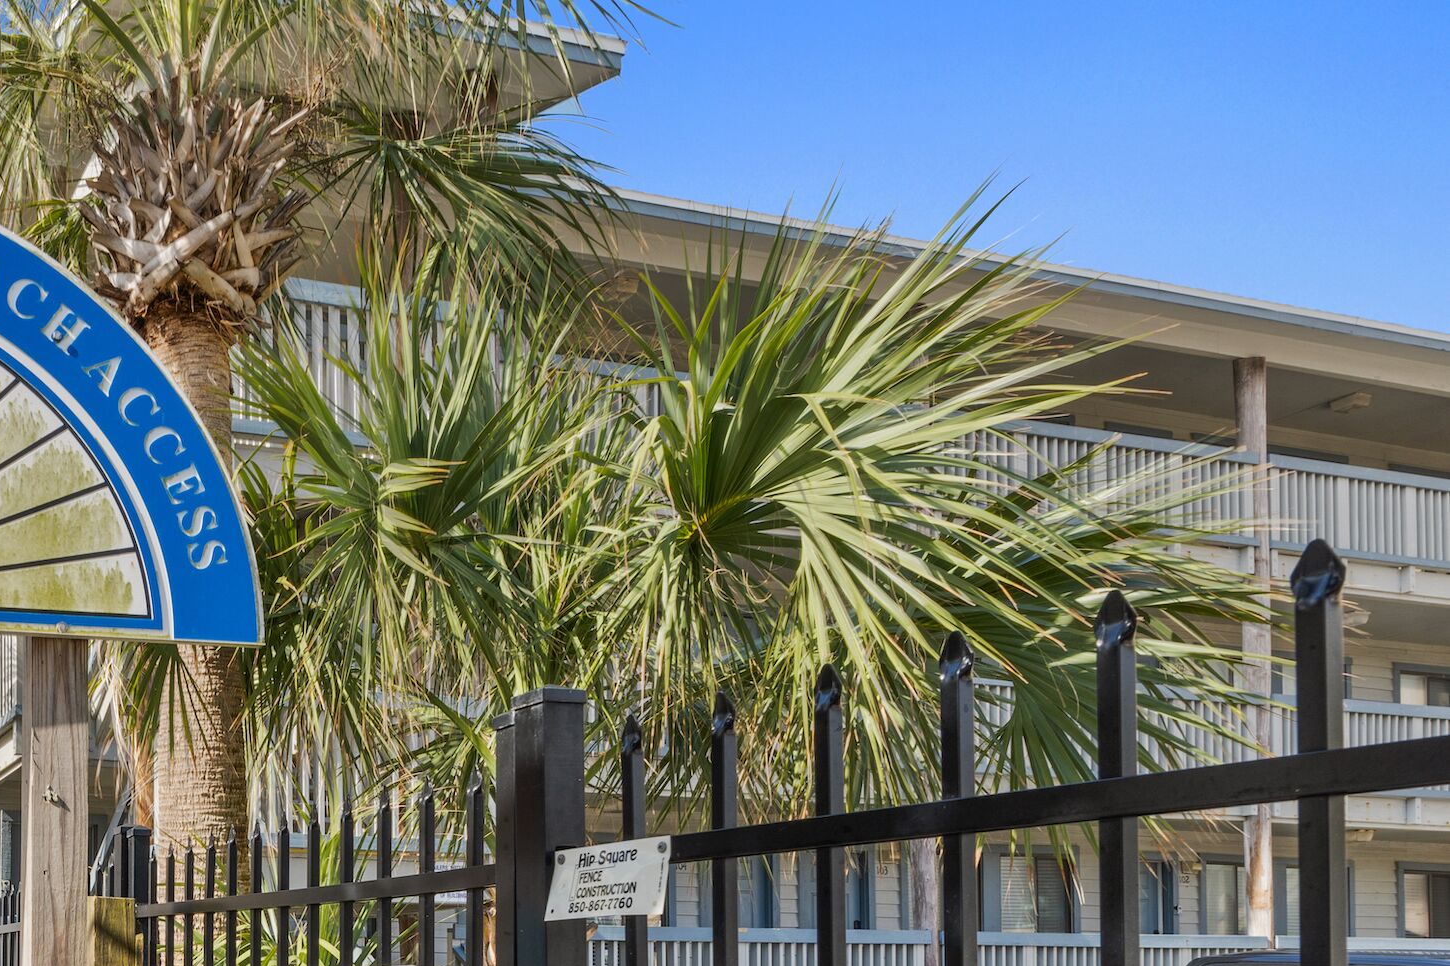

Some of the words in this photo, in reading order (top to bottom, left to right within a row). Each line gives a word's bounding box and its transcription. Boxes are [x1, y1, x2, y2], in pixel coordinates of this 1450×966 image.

[82, 355, 229, 571] ACCESS
[578, 852, 596, 868] Hip
[598, 848, 638, 866] Square
[578, 870, 603, 884] FENCE
[576, 882, 637, 899] CONSTRUCTION
[568, 897, 633, 914] 850-867-7760
